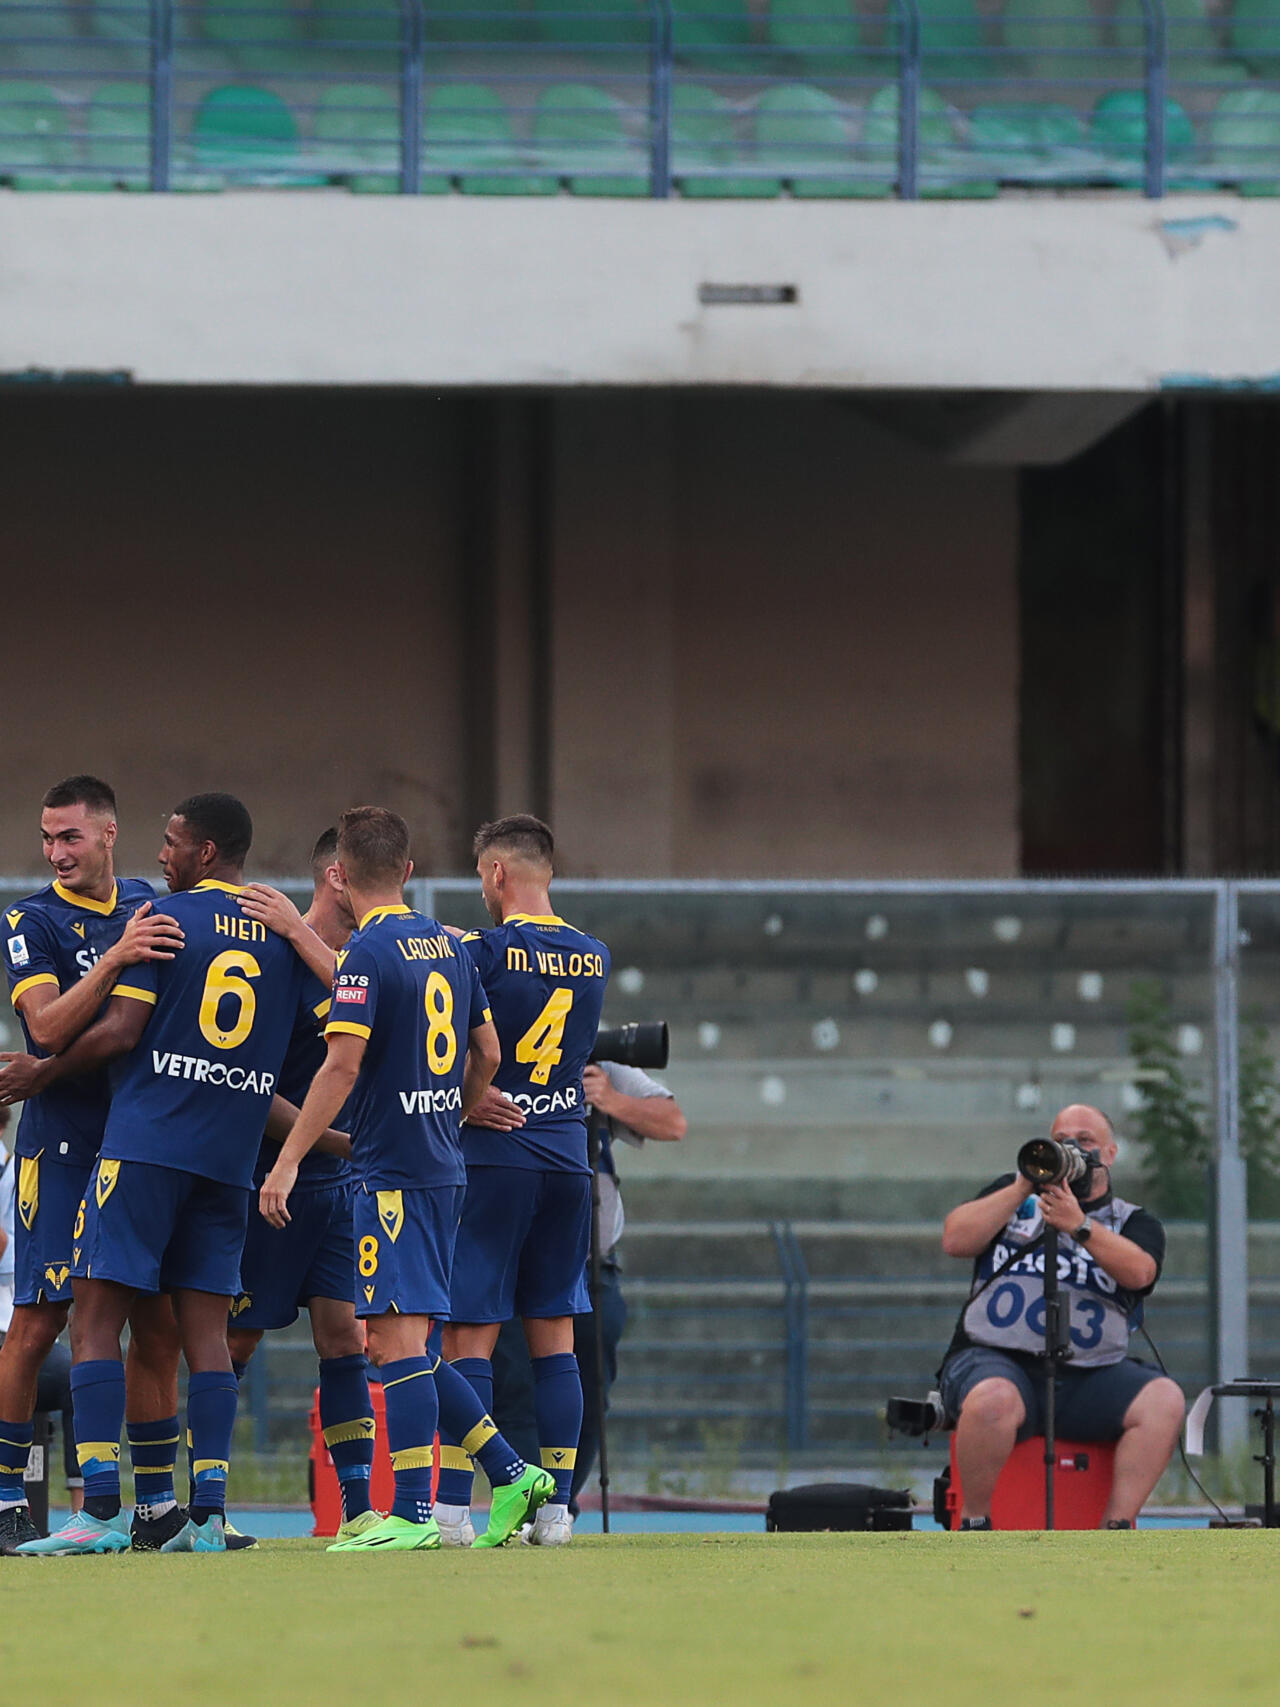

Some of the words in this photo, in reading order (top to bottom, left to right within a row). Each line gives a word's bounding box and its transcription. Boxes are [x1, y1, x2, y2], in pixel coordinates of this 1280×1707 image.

[214, 913, 266, 942] HIEN
[506, 947, 533, 973] M.
[535, 951, 604, 977] VELOSO
[198, 949, 262, 1050] 6
[336, 989, 364, 1001] RENT
[424, 971, 458, 1076] 8
[515, 987, 575, 1086] 4
[152, 1050, 275, 1096] VETROCAR
[358, 1234, 379, 1278] 8
